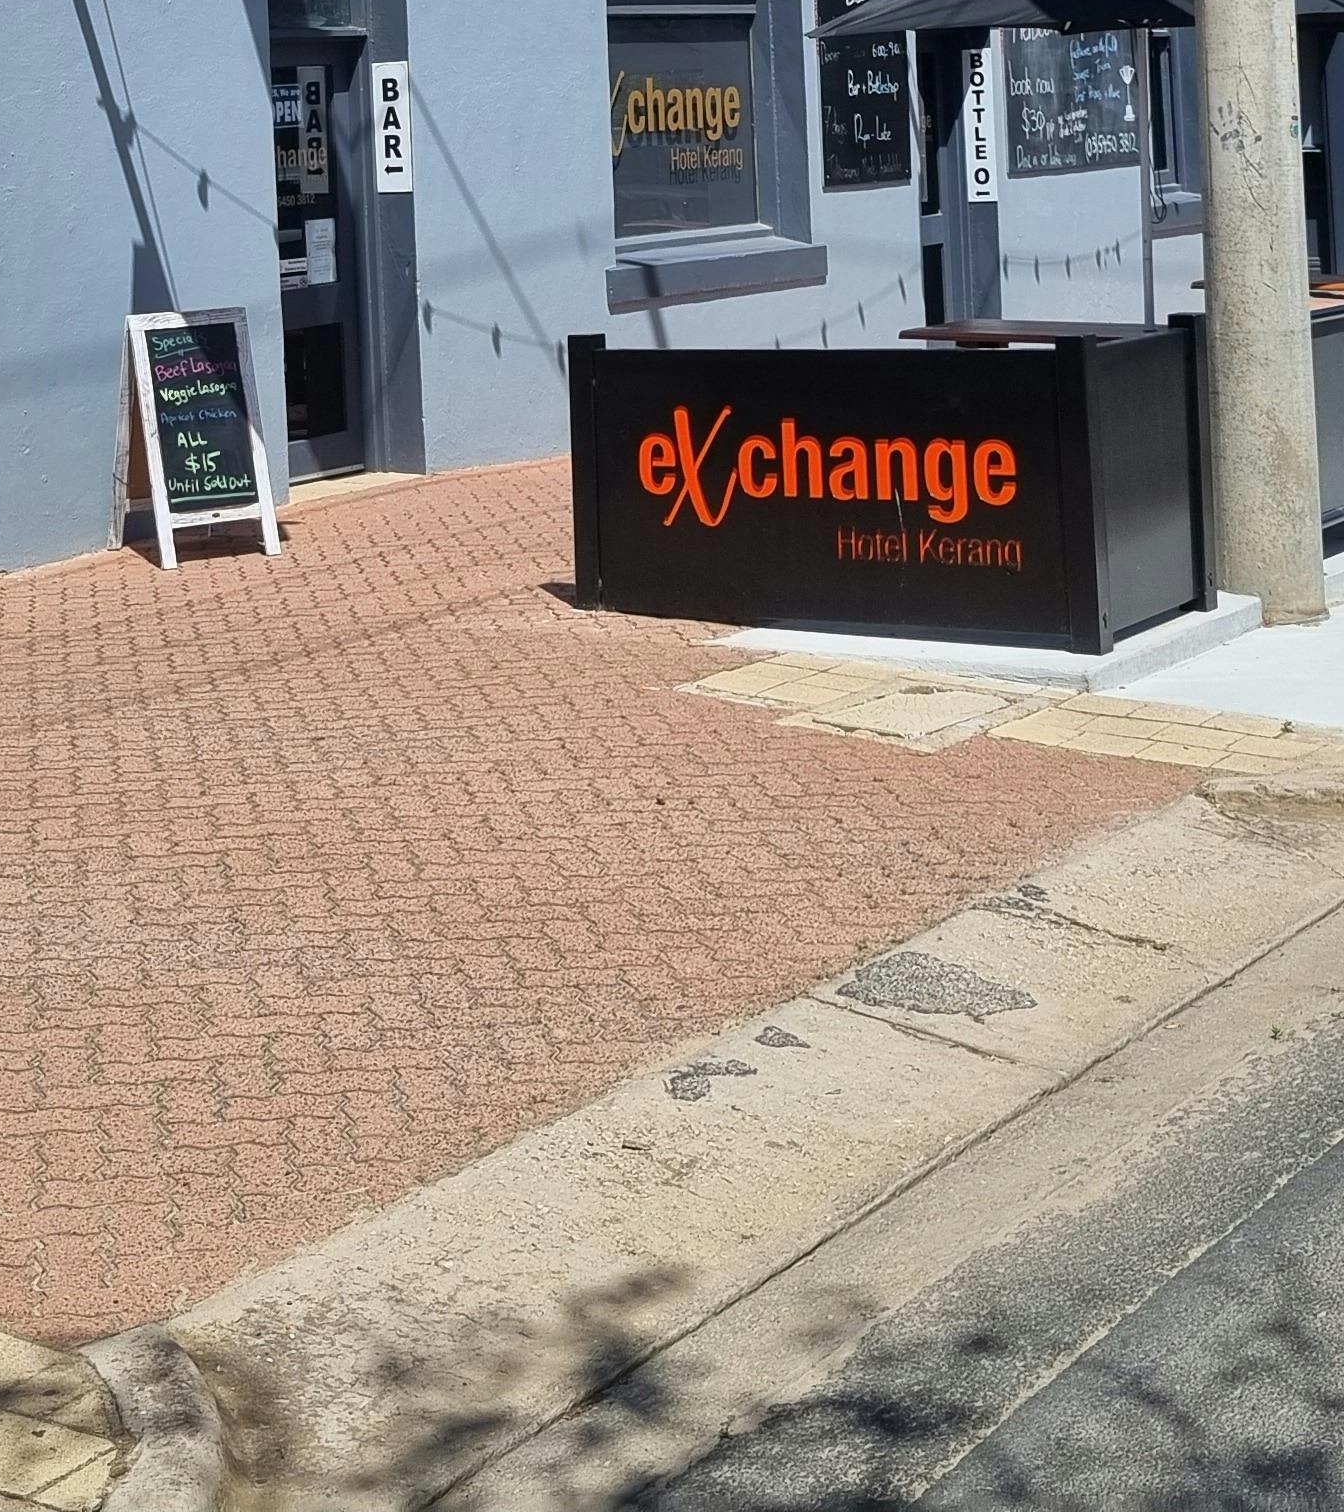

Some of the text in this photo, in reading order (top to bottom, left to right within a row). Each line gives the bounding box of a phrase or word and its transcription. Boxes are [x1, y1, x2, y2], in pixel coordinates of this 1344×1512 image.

[382, 78, 402, 159] BAR
[611, 70, 740, 157] change
[970, 53, 990, 185] BOTTLE O
[276, 145, 327, 170] hange
[671, 145, 743, 170] Hotel Kerang
[154, 359, 188, 382] Beef
[160, 385, 197, 405] Veggie
[198, 408, 237, 420] Chicken
[177, 431, 208, 448] ALL
[185, 450, 221, 474] $15
[169, 473, 252, 493] Until Sold Out
[837, 526, 1022, 571] Hotel Kerang
